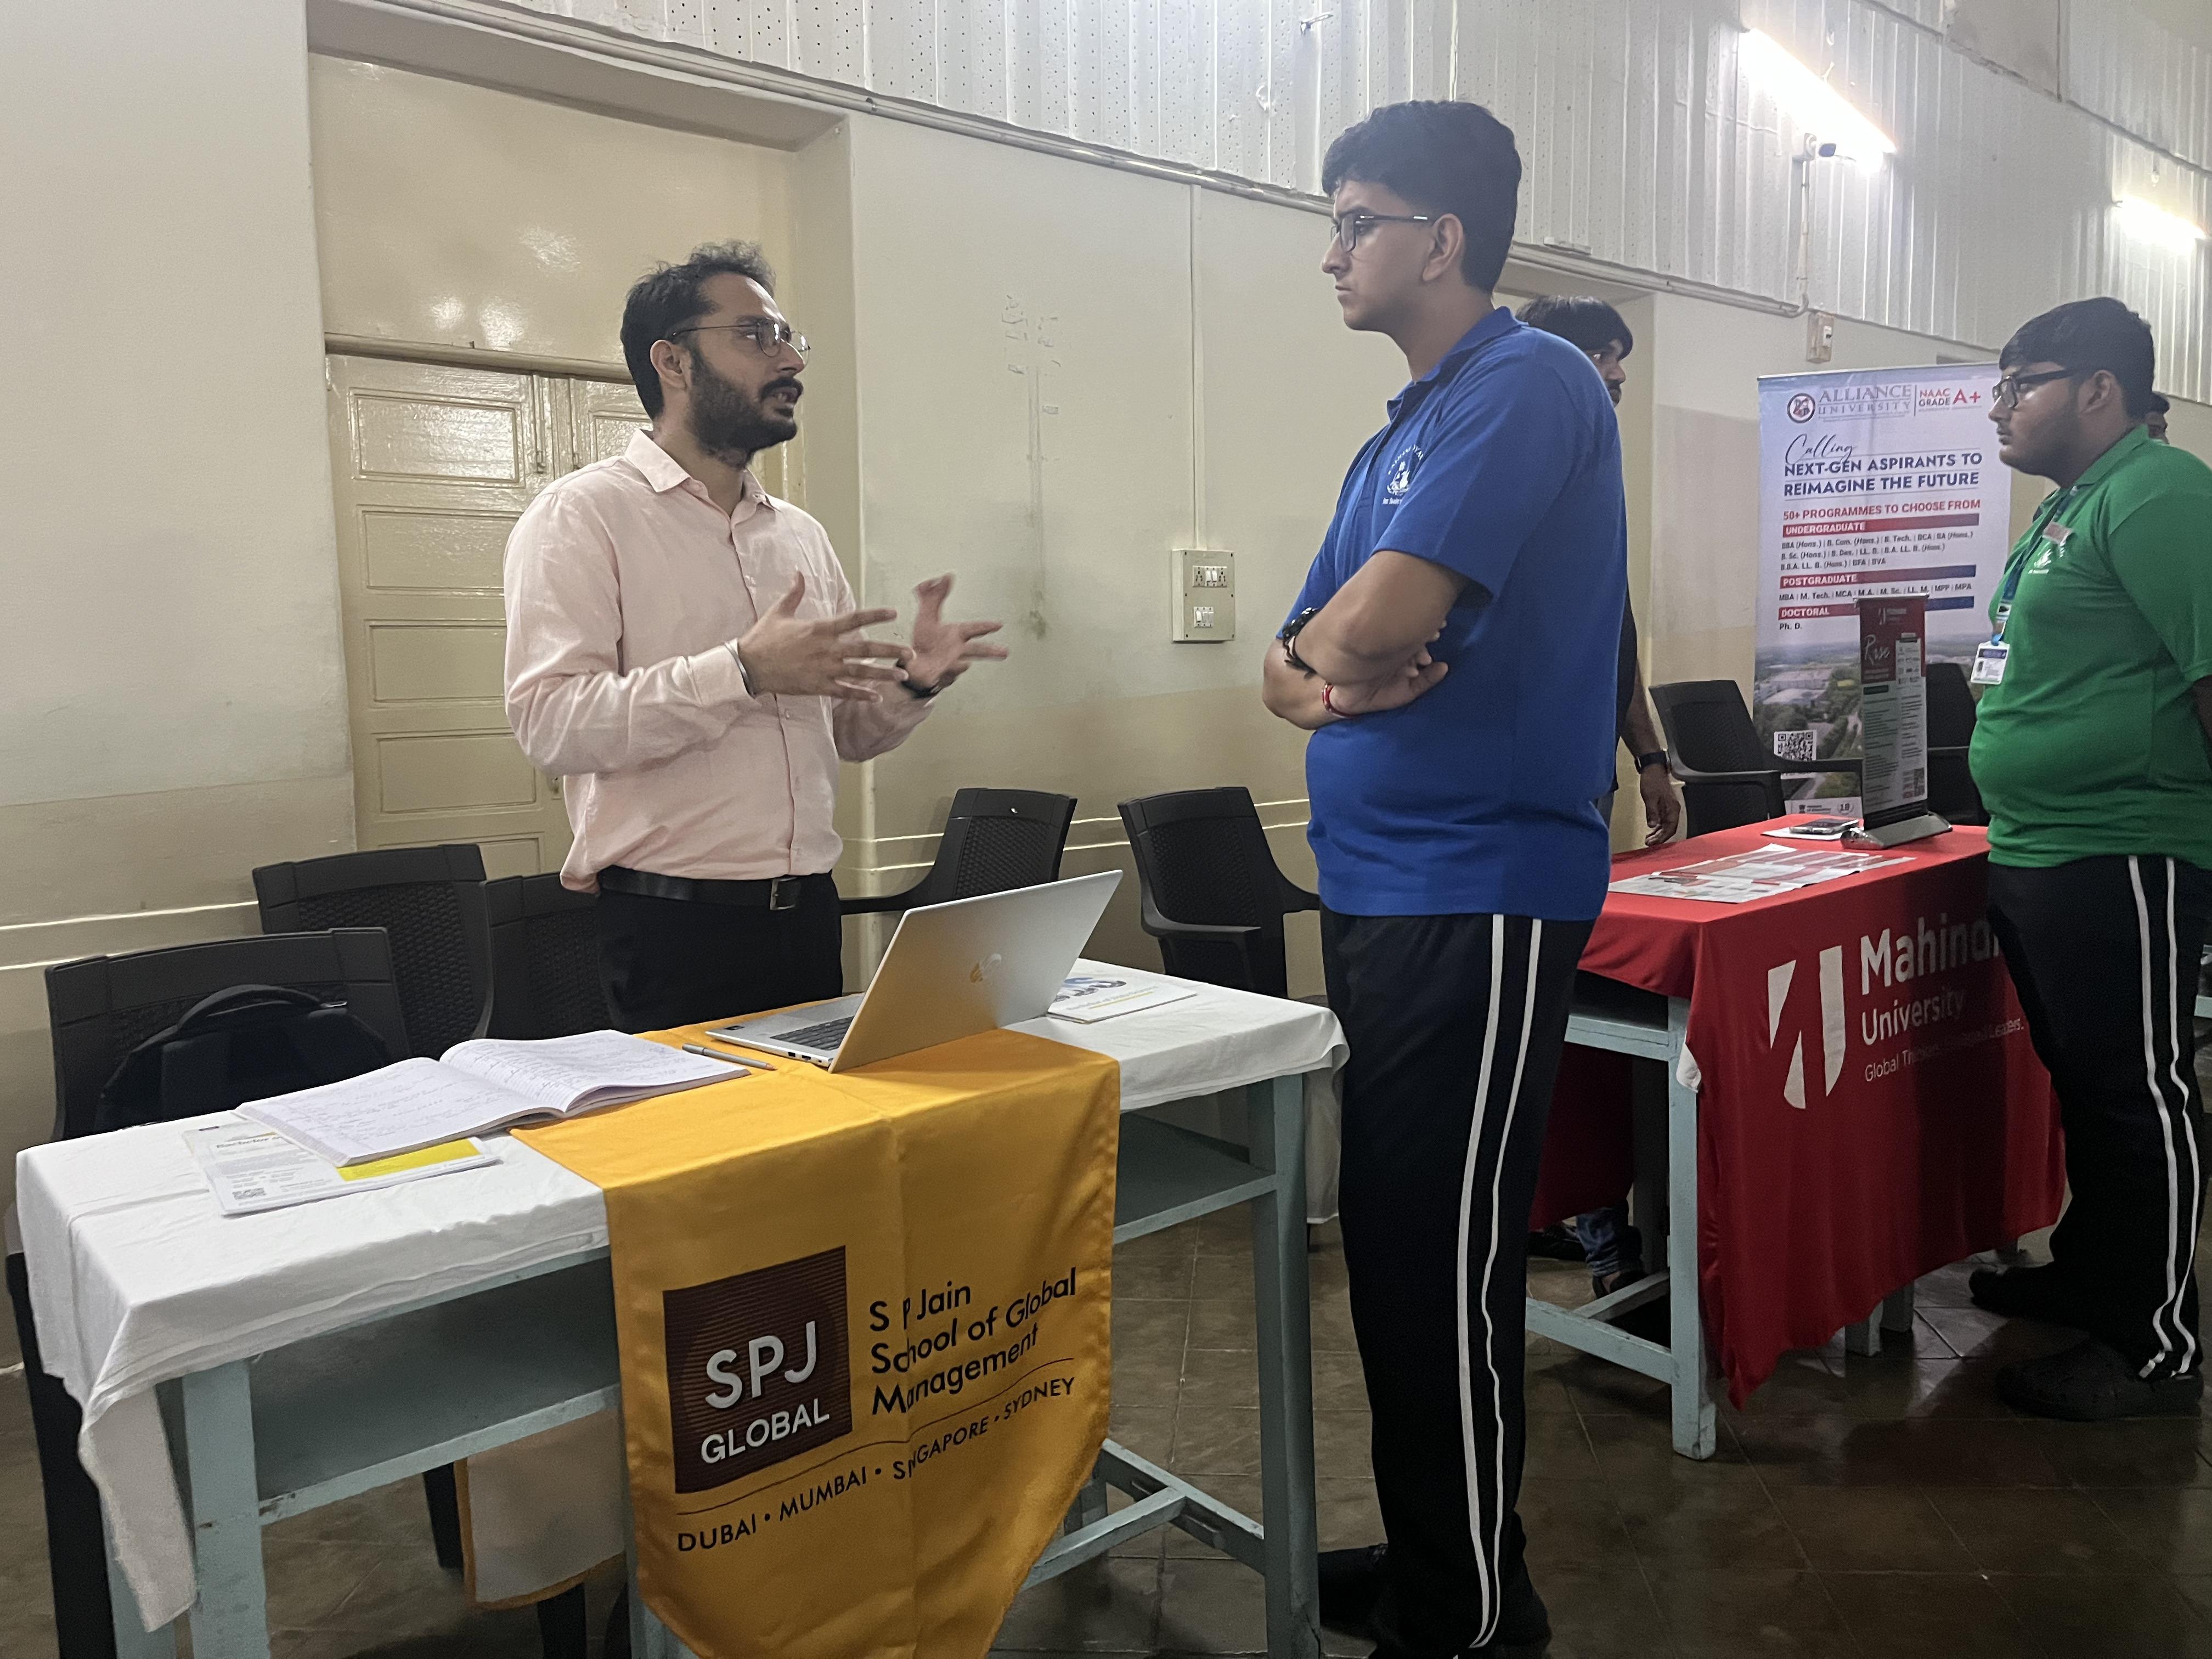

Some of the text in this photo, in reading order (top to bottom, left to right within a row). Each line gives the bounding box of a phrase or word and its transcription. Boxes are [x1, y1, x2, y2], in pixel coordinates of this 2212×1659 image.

[1819, 385, 1912, 402] ALLIANCE
[1918, 397, 1950, 407] GRADE
[1920, 388, 1981, 404] NAAC A+
[1818, 401, 1910, 415] UNIVERSITY
[1785, 433, 1857, 465] Calling
[1785, 453, 1983, 477] NEXT-GEN ASPIRANTS TO
[1784, 472, 1979, 496] REIMAGINE THE FUTURE
[1784, 499, 1981, 520] 50+ PROGRAMMES TO CHOOSE FROM
[1785, 522, 1866, 535] UNDERGRADUATE
[1783, 574, 1858, 587] POSTGRADUATE
[1781, 607, 1830, 618] DOCTORAL
[1779, 622, 1791, 630] Ph.
[1861, 986, 1965, 1046] University
[1865, 1053, 1899, 1082] Global
[869, 1300, 890, 1331] S
[916, 1280, 971, 1321] Jain
[871, 1266, 1076, 1374] School of Global
[705, 1320, 816, 1410] SPJ
[872, 1322, 1039, 1415] Management
[701, 1397, 831, 1465] GLOBAL
[678, 1376, 1075, 1553] DUBAI MUMBAI SINGAPORE SYDNEY
